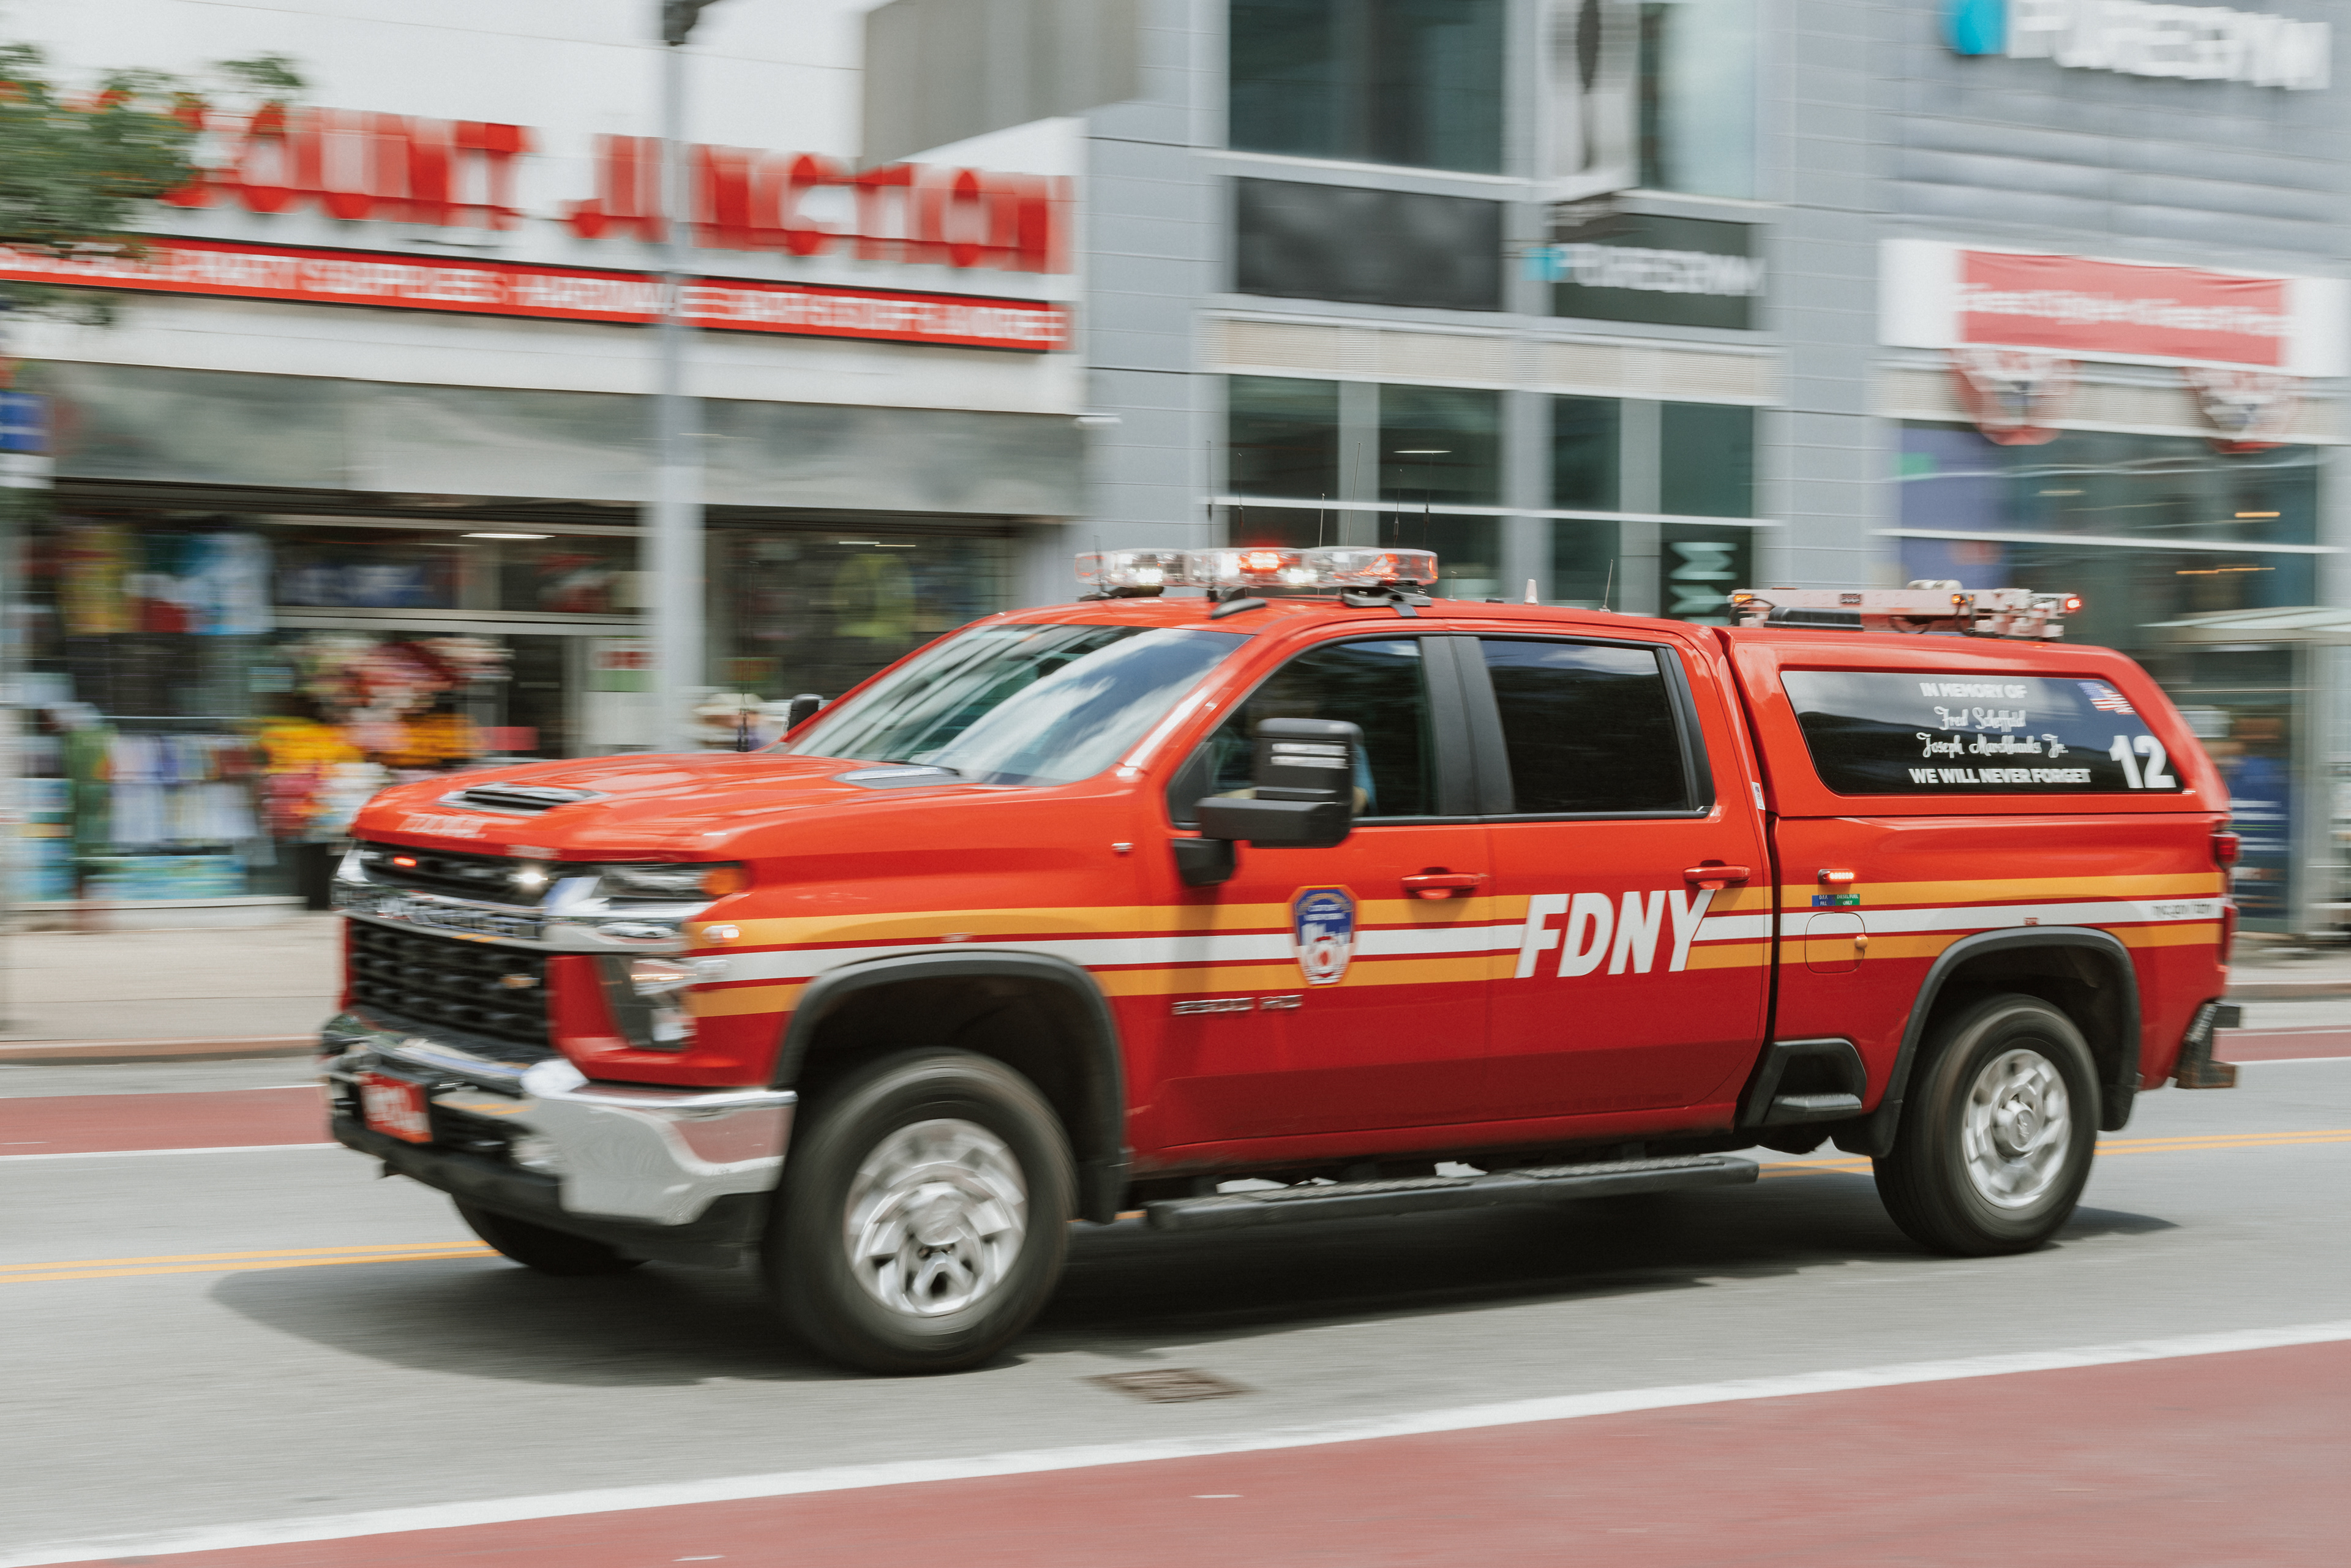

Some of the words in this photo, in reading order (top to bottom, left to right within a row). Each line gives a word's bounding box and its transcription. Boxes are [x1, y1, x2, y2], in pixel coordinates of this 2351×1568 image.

[1919, 683, 1940, 697] IN
[1938, 683, 2004, 698] MEMORY
[2004, 685, 2028, 699] OF
[1916, 732, 1965, 758] Joseph
[2108, 735, 2177, 789] 12
[1908, 768, 1939, 783] WE
[1937, 768, 1981, 783] WILL
[1978, 768, 2033, 783] NEVER
[2030, 768, 2091, 783] FORGET
[1513, 889, 1716, 978] FDNY
